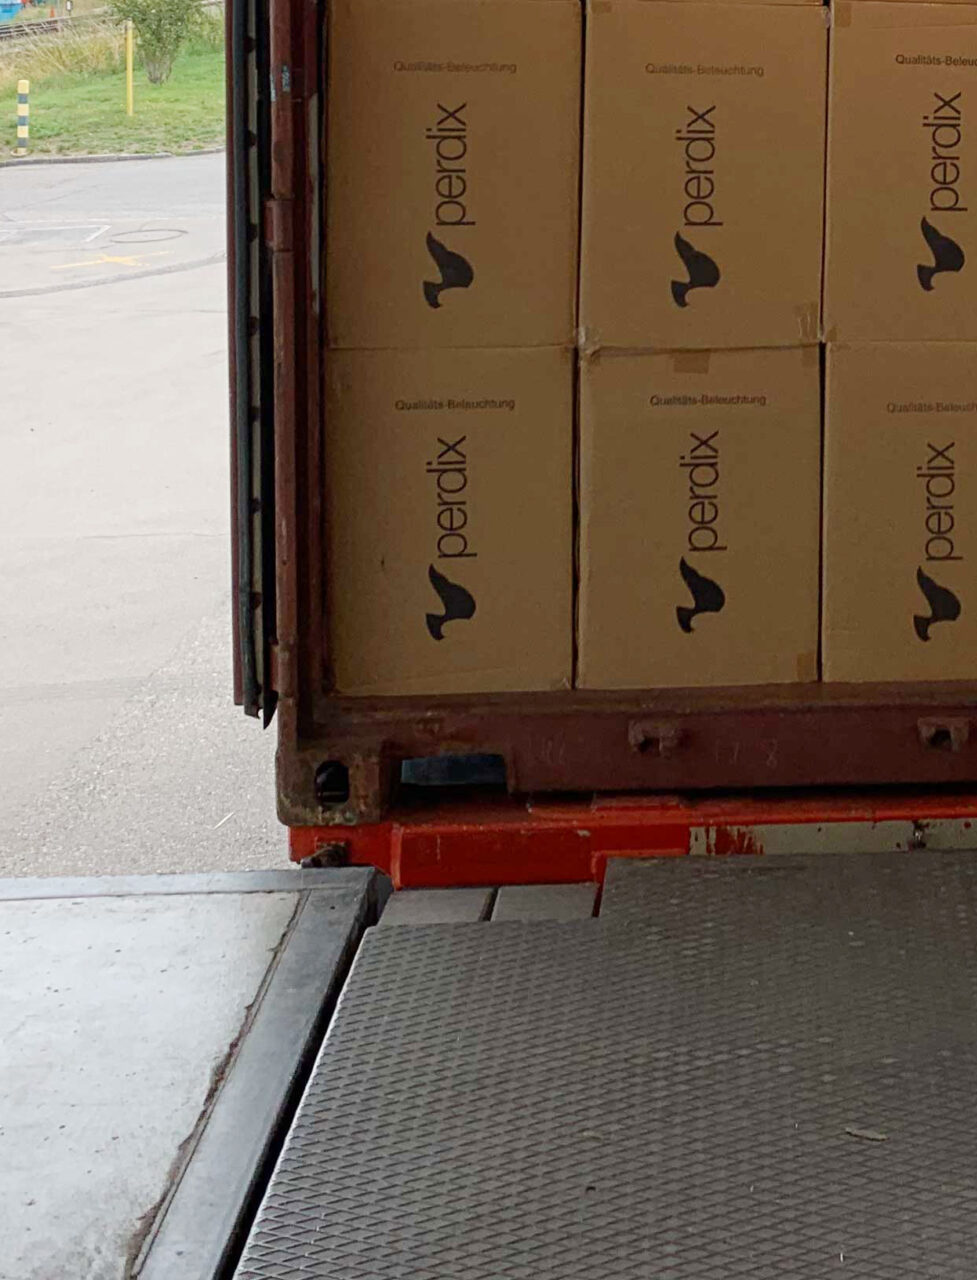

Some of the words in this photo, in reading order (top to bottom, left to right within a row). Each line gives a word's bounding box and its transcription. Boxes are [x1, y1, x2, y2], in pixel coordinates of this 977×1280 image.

[426, 103, 476, 225] perdix
[676, 106, 723, 227] perdix
[921, 92, 968, 213] perdix
[426, 436, 477, 559] perdix
[680, 431, 727, 553] perdix
[917, 442, 963, 563] perdix
